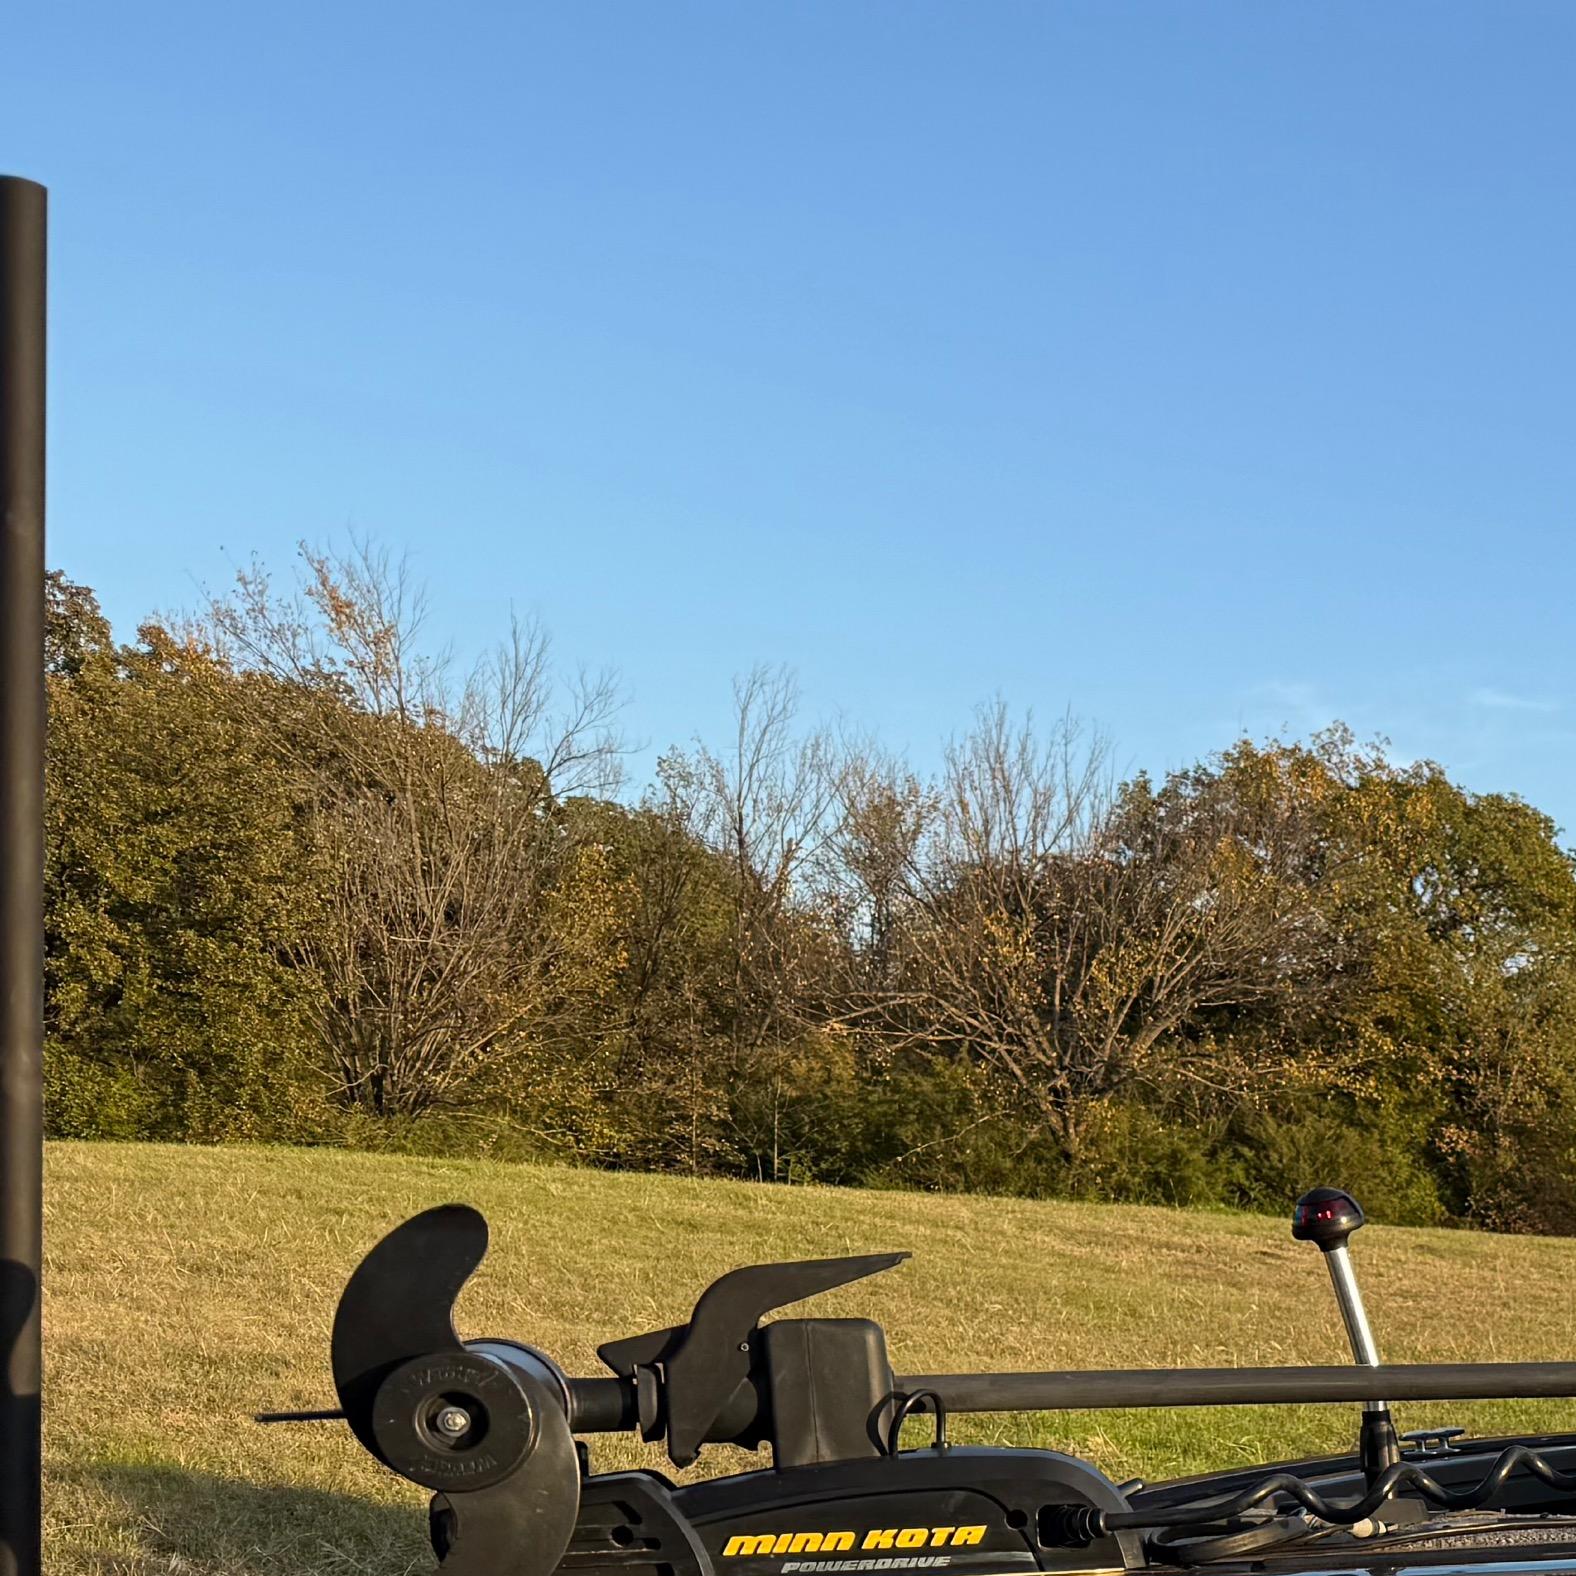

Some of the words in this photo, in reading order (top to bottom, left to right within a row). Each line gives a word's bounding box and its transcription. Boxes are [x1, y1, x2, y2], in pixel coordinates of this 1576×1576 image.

[722, 1531, 856, 1556] MINN
[861, 1525, 987, 1550] KOTA
[780, 1556, 952, 1574] POWERDRIVE
